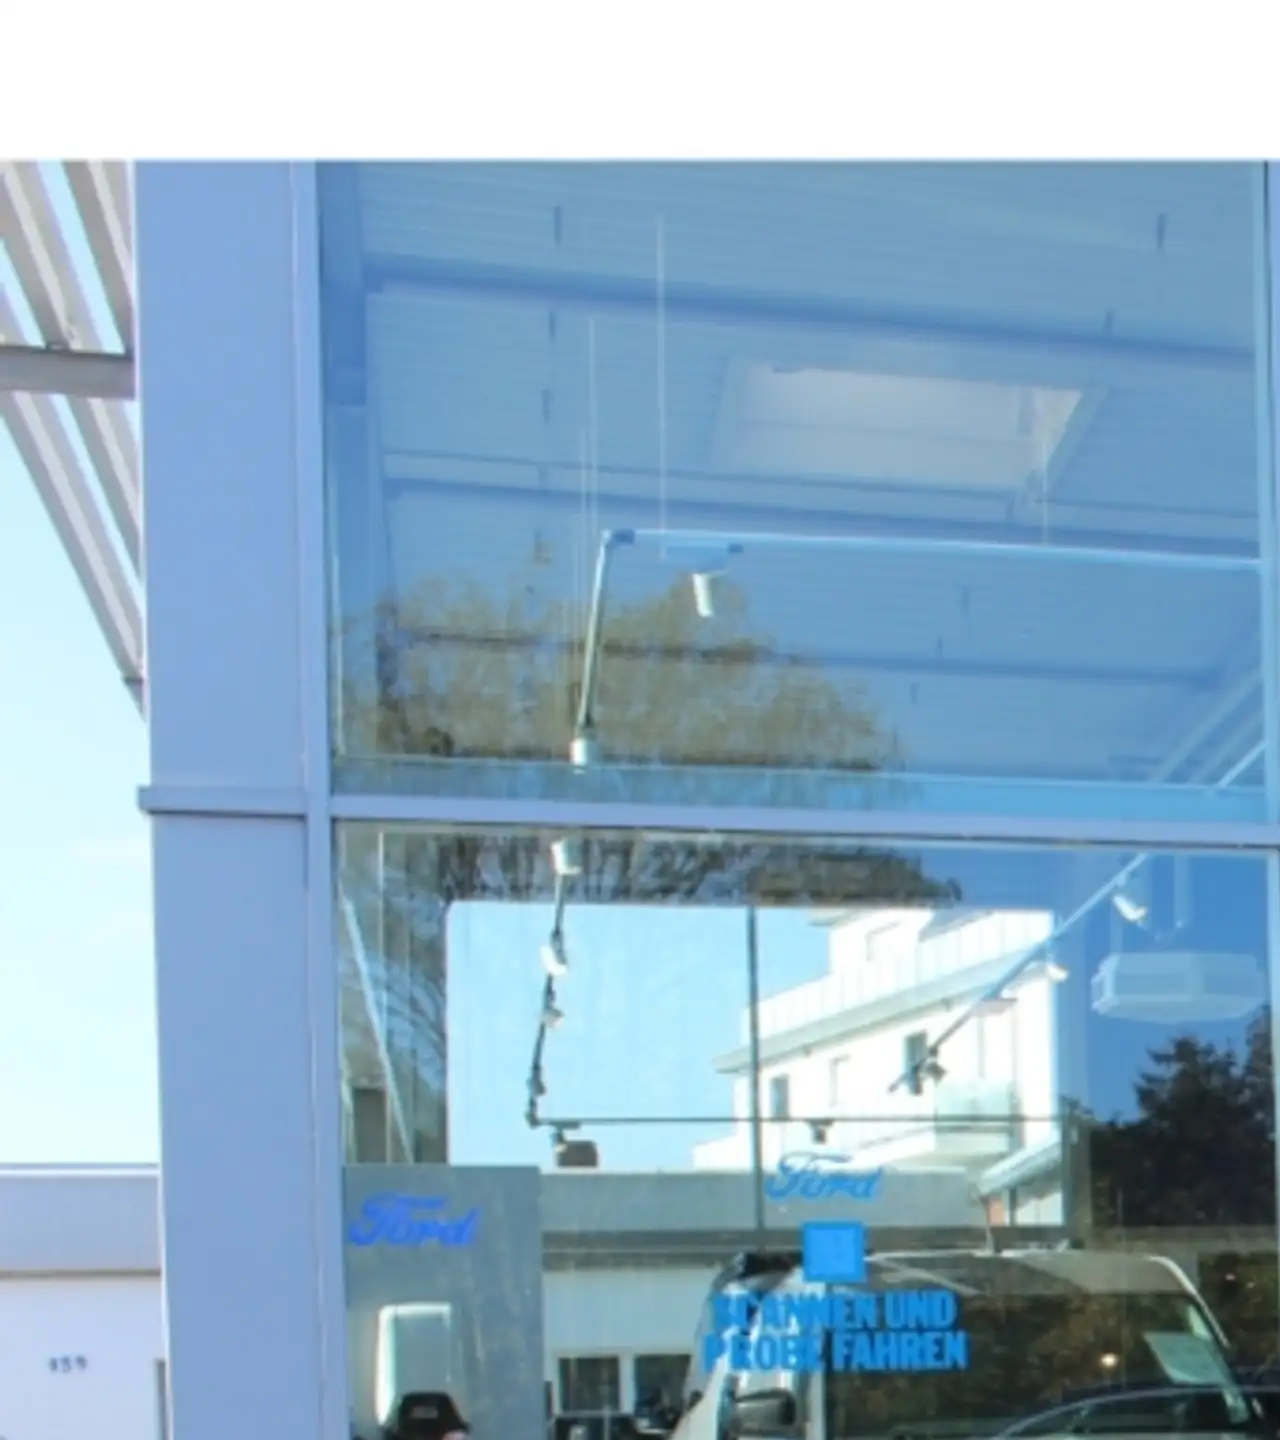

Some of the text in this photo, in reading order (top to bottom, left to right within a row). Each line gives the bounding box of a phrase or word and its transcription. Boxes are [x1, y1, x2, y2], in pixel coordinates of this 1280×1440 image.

[764, 1151, 884, 1199] Ford
[348, 1191, 479, 1246] Ford
[884, 1288, 957, 1330] UND
[703, 1330, 970, 1372] PROBE FAHREN
